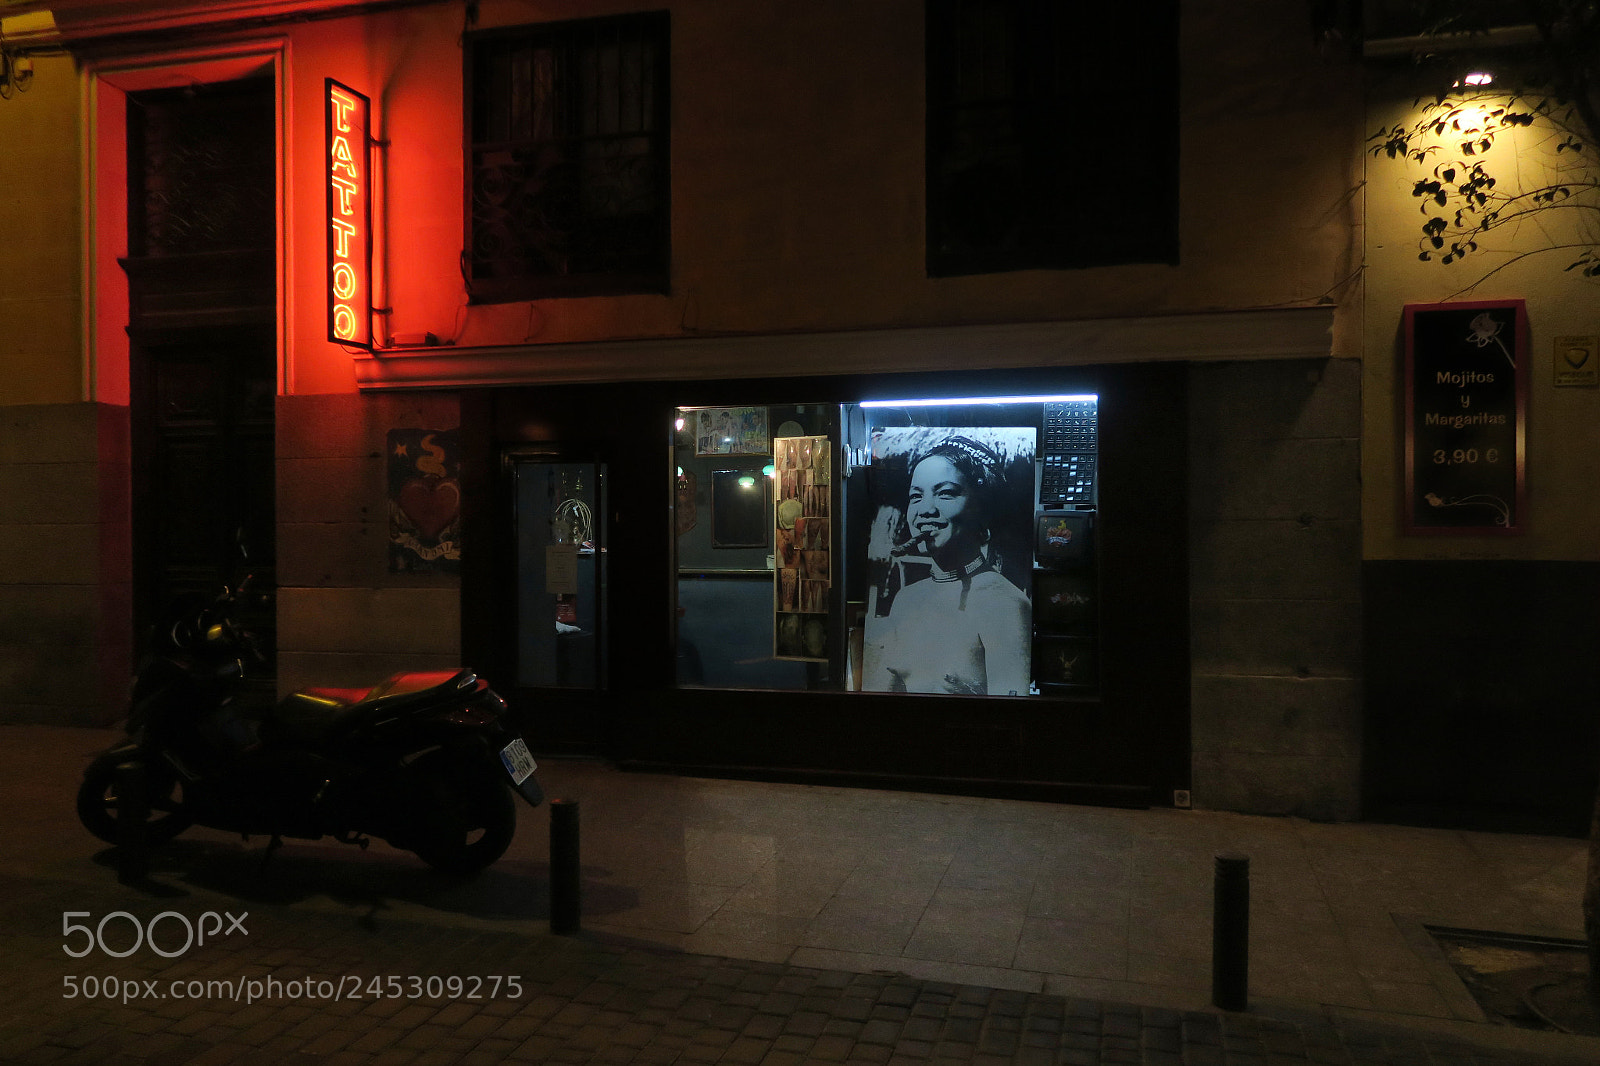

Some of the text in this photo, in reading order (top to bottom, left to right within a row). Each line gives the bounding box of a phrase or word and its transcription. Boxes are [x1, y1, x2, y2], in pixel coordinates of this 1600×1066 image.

[331, 90, 356, 341] TATTOO
[1437, 371, 1495, 387] Mojitos
[1461, 395, 1470, 408] y
[1425, 412, 1507, 429] Margaritas
[1433, 449, 1499, 466] 3,90 €
